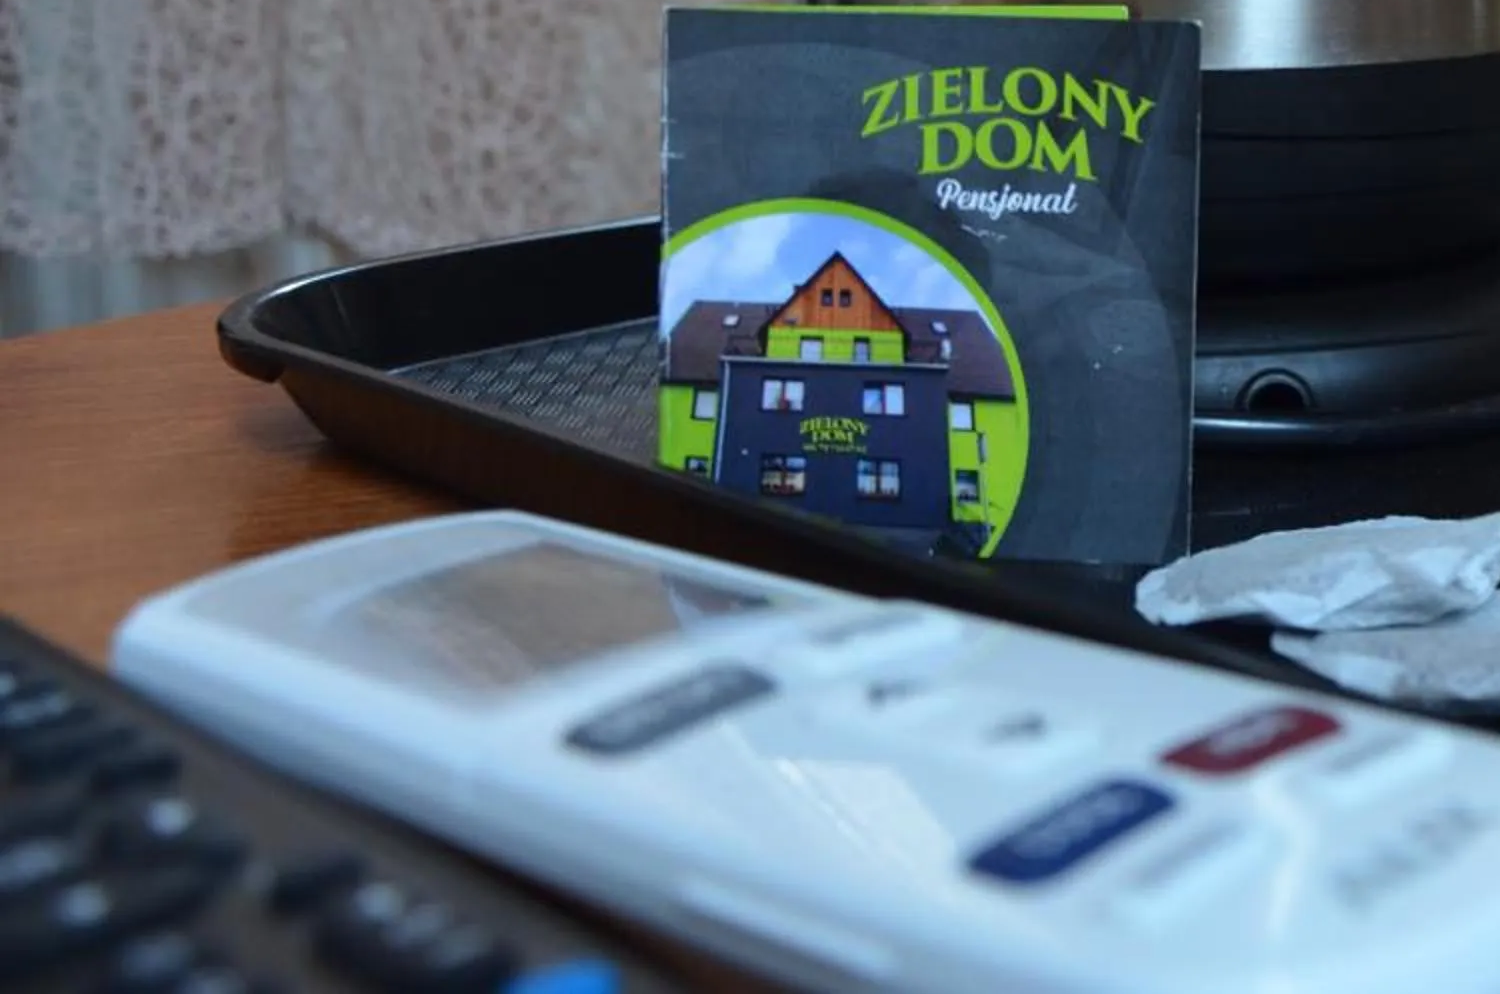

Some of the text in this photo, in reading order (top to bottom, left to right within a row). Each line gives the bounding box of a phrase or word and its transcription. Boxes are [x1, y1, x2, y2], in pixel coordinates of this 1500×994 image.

[860, 66, 1155, 143] ZIELONY
[918, 116, 1097, 180] DOM
[936, 178, 1078, 221] Pensjonat
